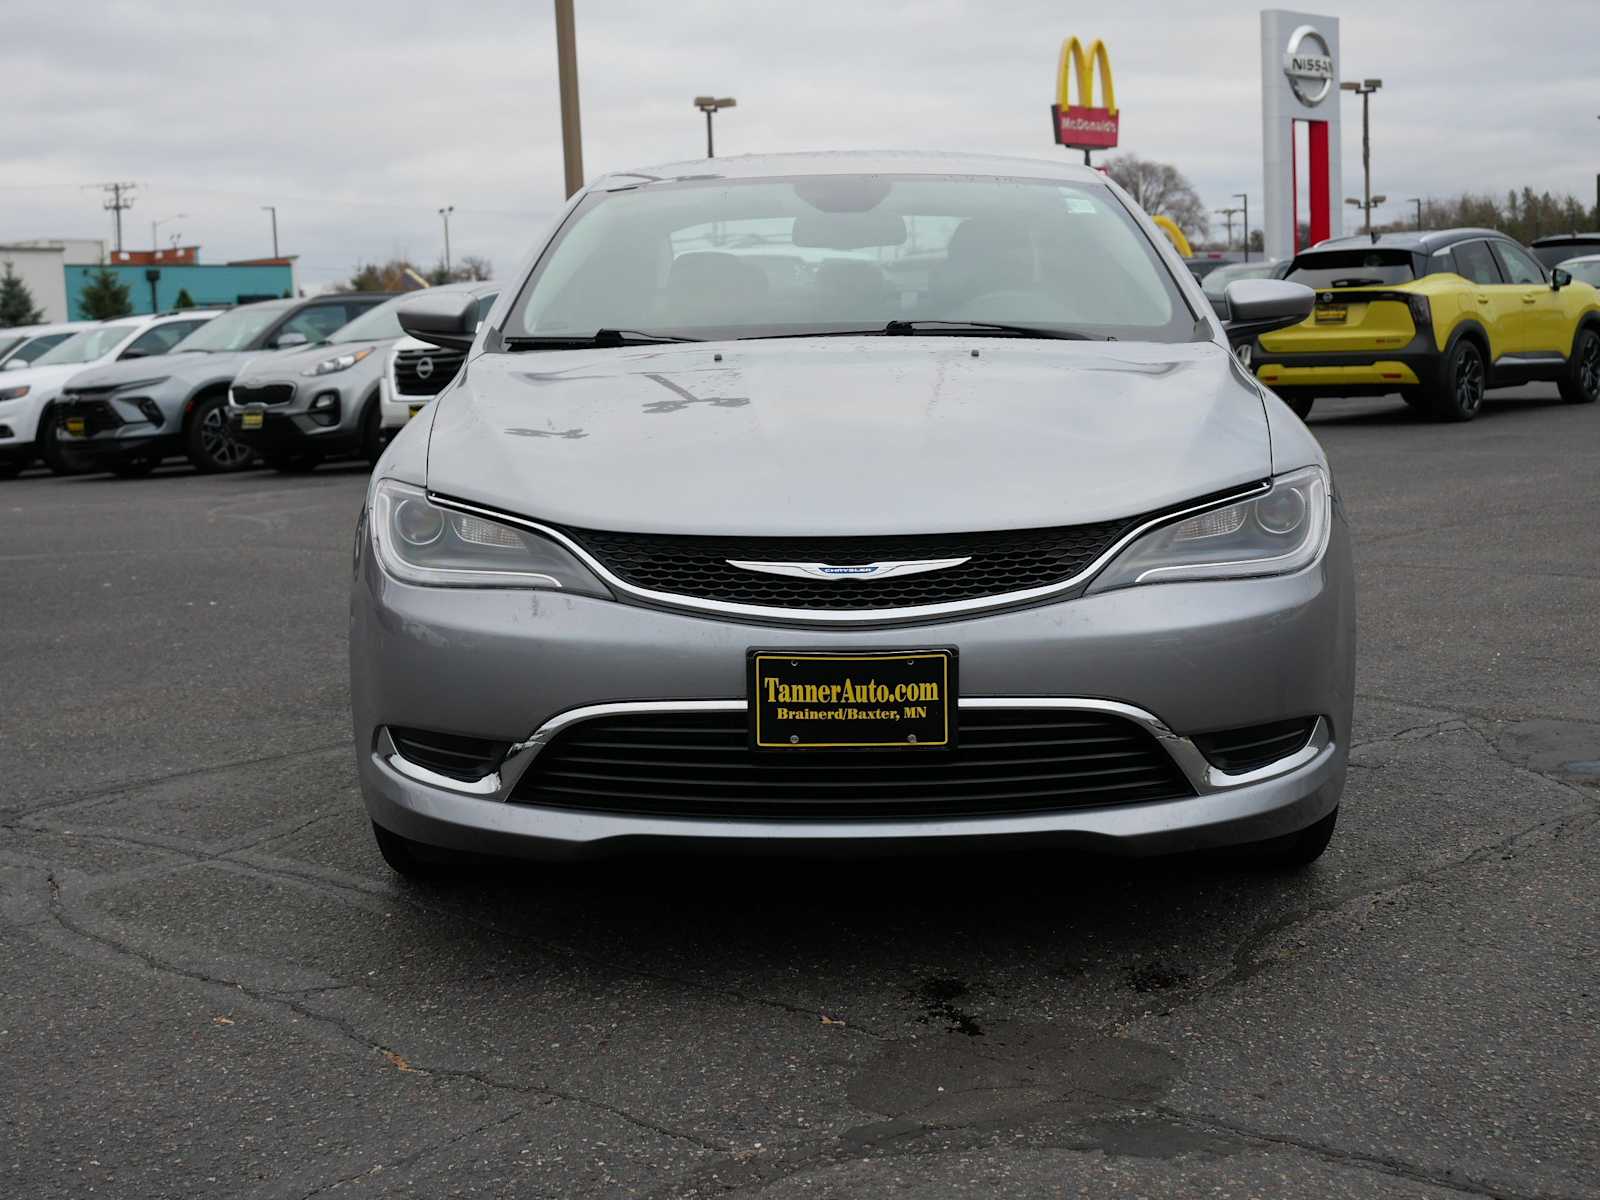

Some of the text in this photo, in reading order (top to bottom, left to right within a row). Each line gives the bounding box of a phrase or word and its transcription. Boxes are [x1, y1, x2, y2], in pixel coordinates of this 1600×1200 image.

[765, 677, 939, 703] TannerAuto.com
[777, 706, 927, 721] Brainerd/Baxter, MN
